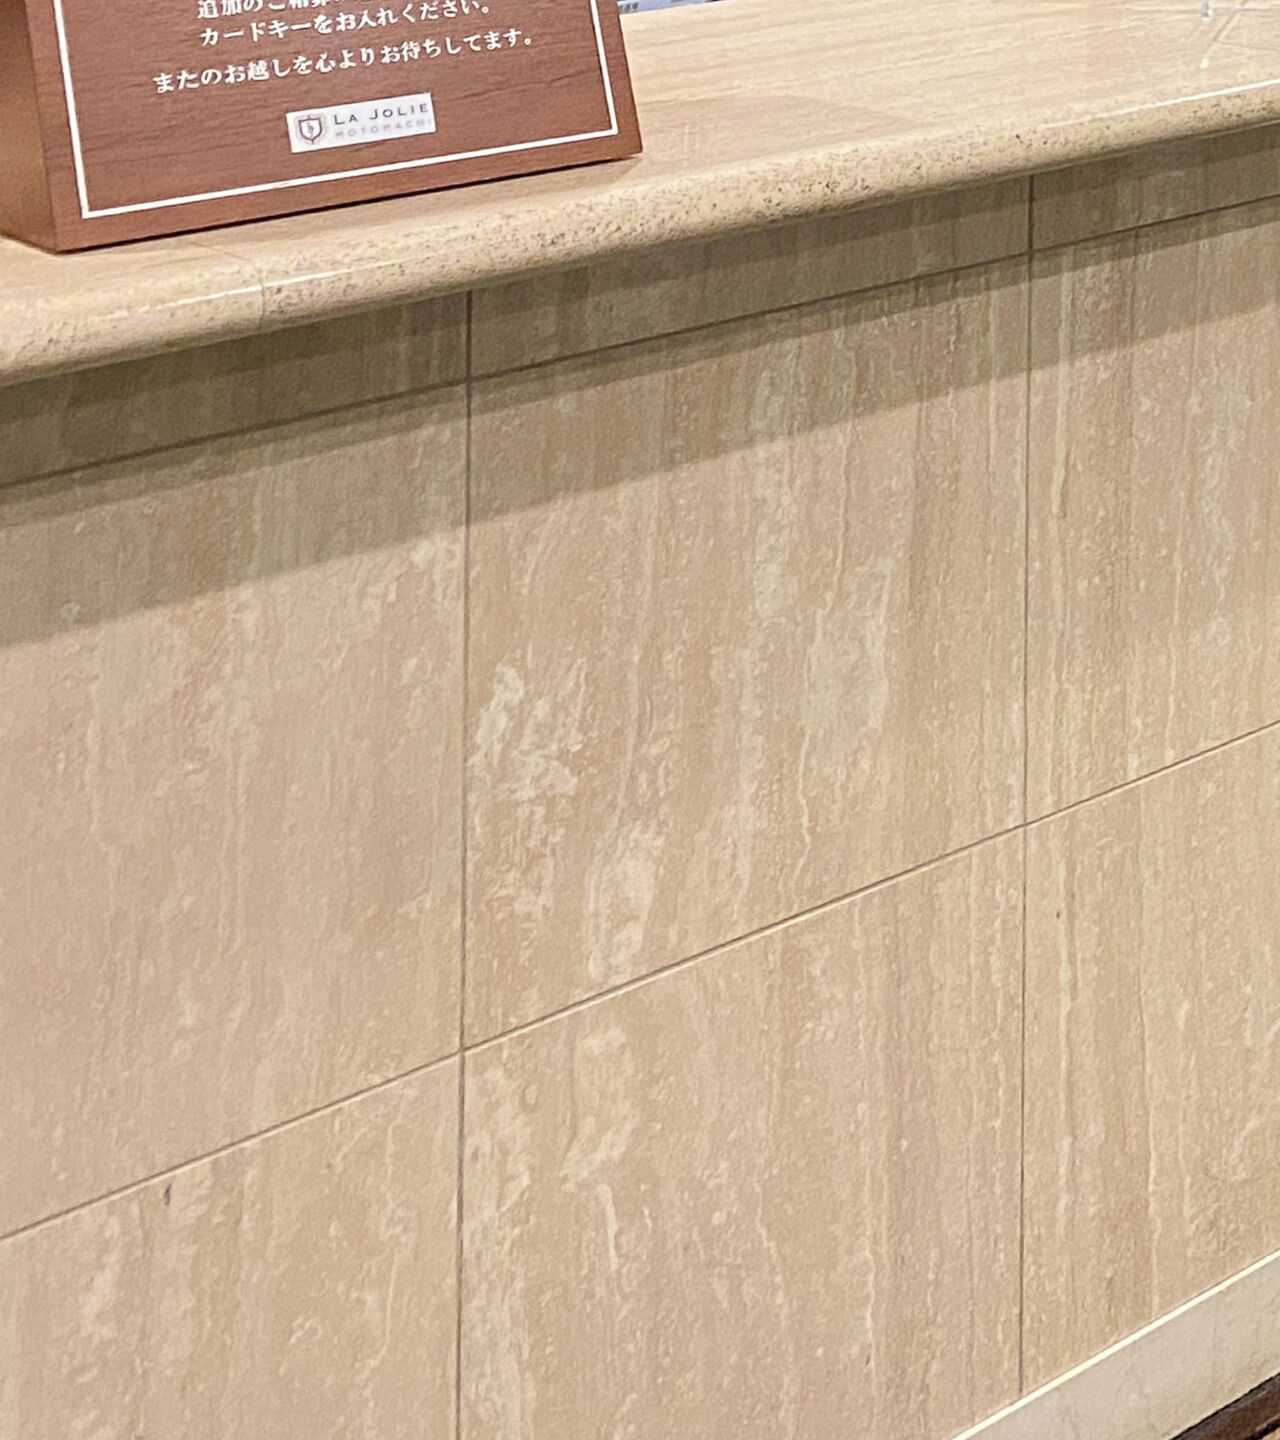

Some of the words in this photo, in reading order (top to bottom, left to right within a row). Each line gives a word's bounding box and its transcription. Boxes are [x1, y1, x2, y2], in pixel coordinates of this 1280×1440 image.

[200, 0, 492, 47] カードキーをお入れください。
[152, 28, 532, 94] またのお越しを心よりお待ちしてます。
[333, 114, 359, 126] LA
[370, 103, 428, 120] JOLIE
[335, 118, 432, 138] MOTOMACHI
